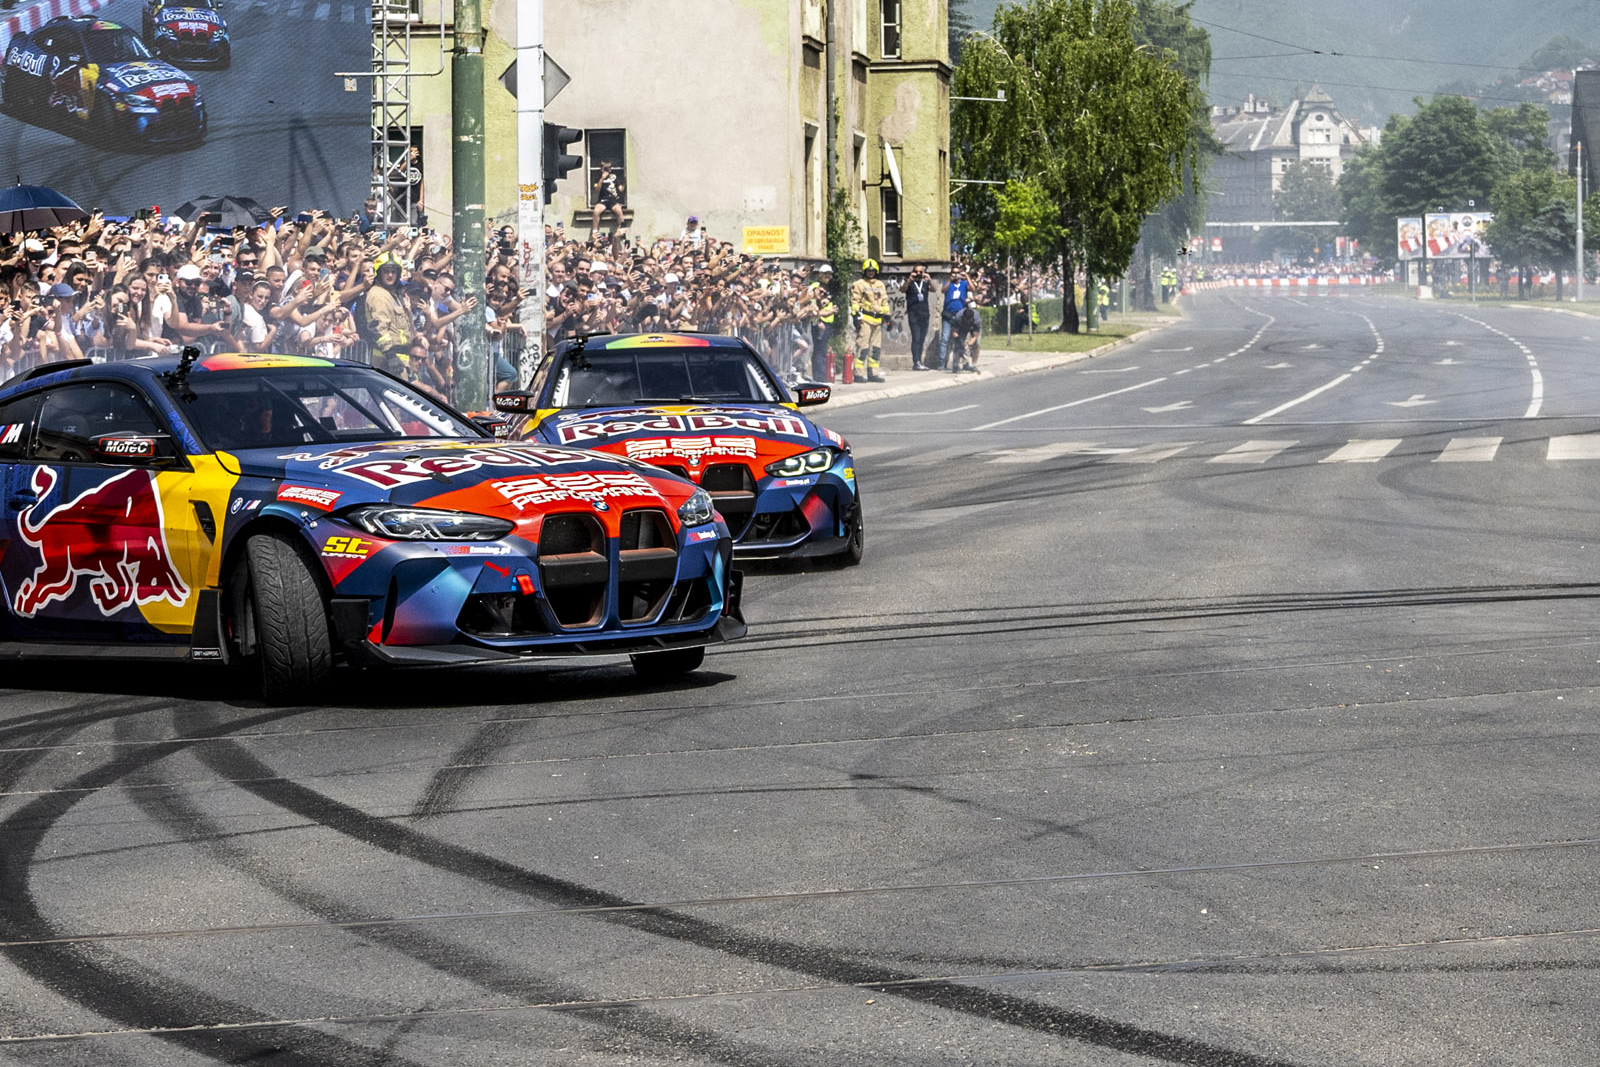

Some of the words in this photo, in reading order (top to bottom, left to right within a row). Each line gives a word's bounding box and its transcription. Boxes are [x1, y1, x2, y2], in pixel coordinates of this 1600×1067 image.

[805, 388, 830, 401] MoTeC
[556, 416, 686, 444] Red
[689, 415, 809, 437] Bull
[105, 440, 149, 454] MoTeC
[628, 445, 757, 460] PERFORMANCE
[332, 447, 543, 490] Red
